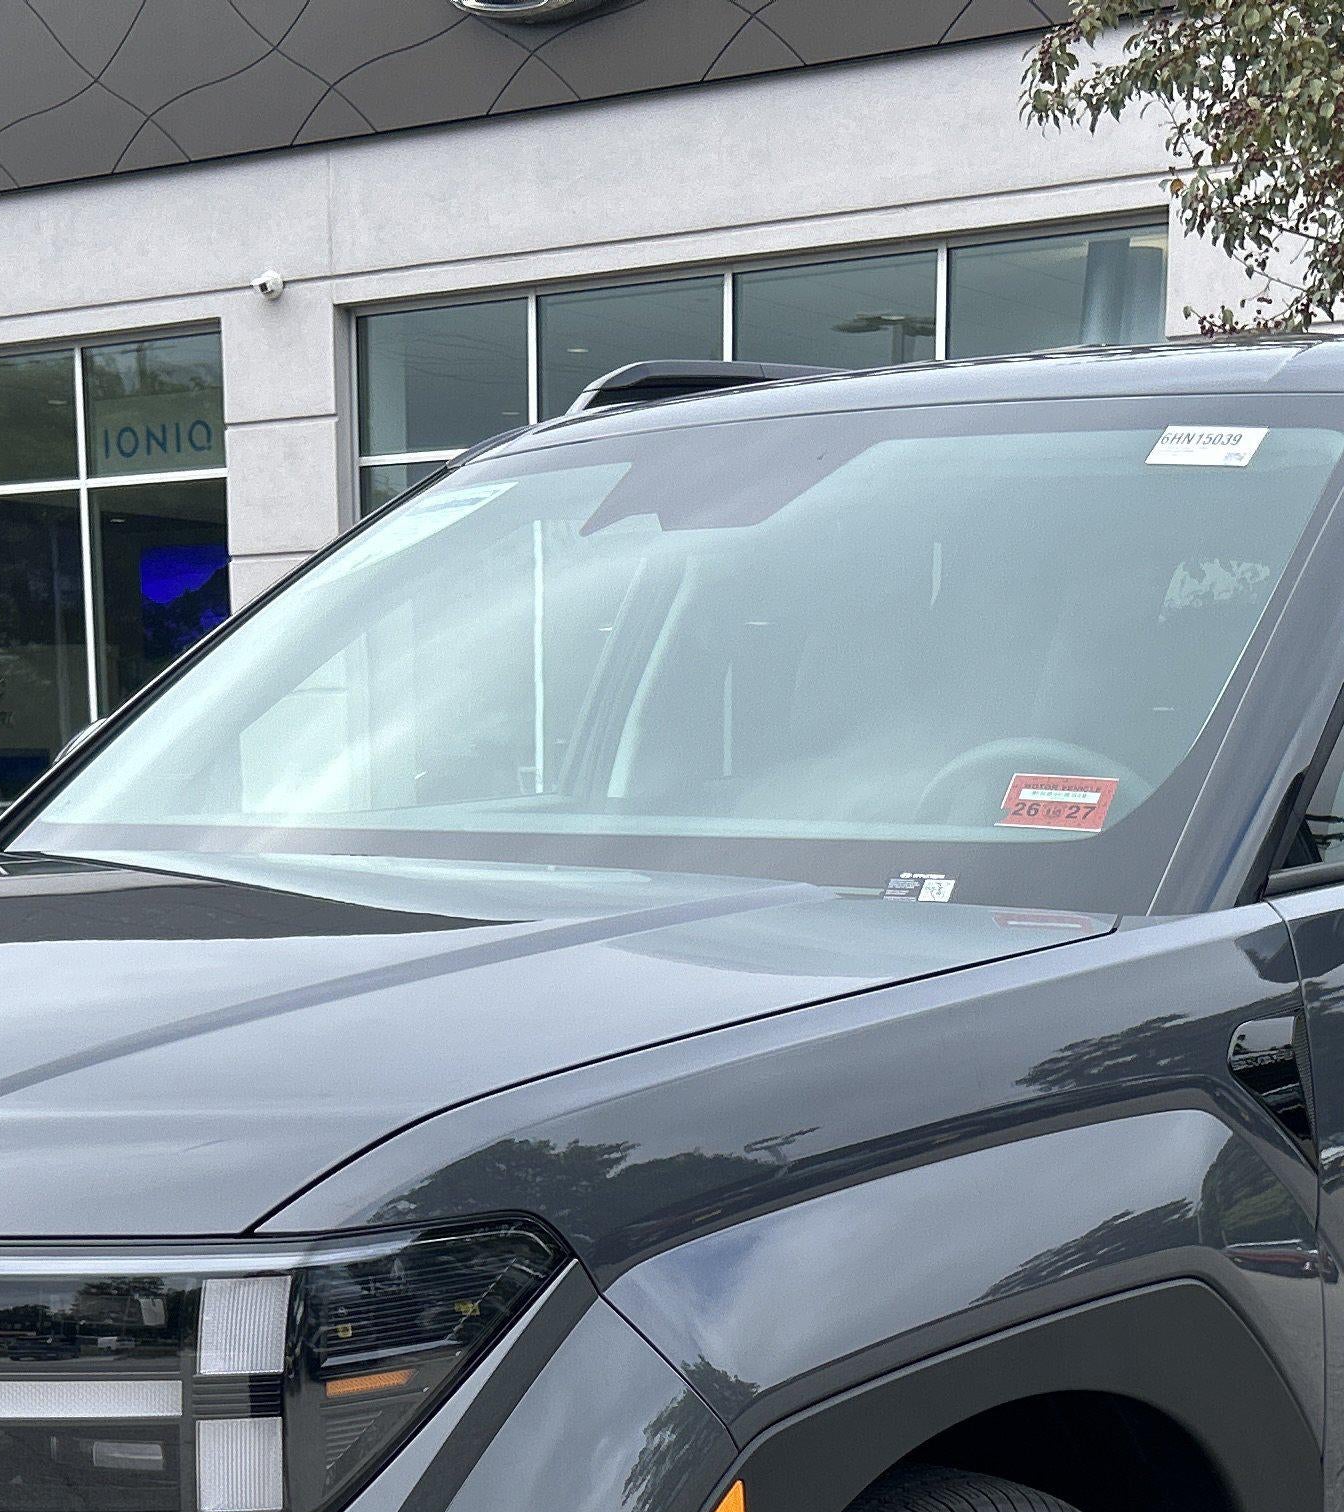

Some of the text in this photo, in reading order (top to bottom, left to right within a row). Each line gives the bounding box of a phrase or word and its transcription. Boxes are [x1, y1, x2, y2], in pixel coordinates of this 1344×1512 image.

[104, 419, 213, 459] IONIQ
[1160, 432, 1243, 446] 6HN15039
[1012, 802, 1041, 817] 26
[1065, 805, 1096, 820] 27
